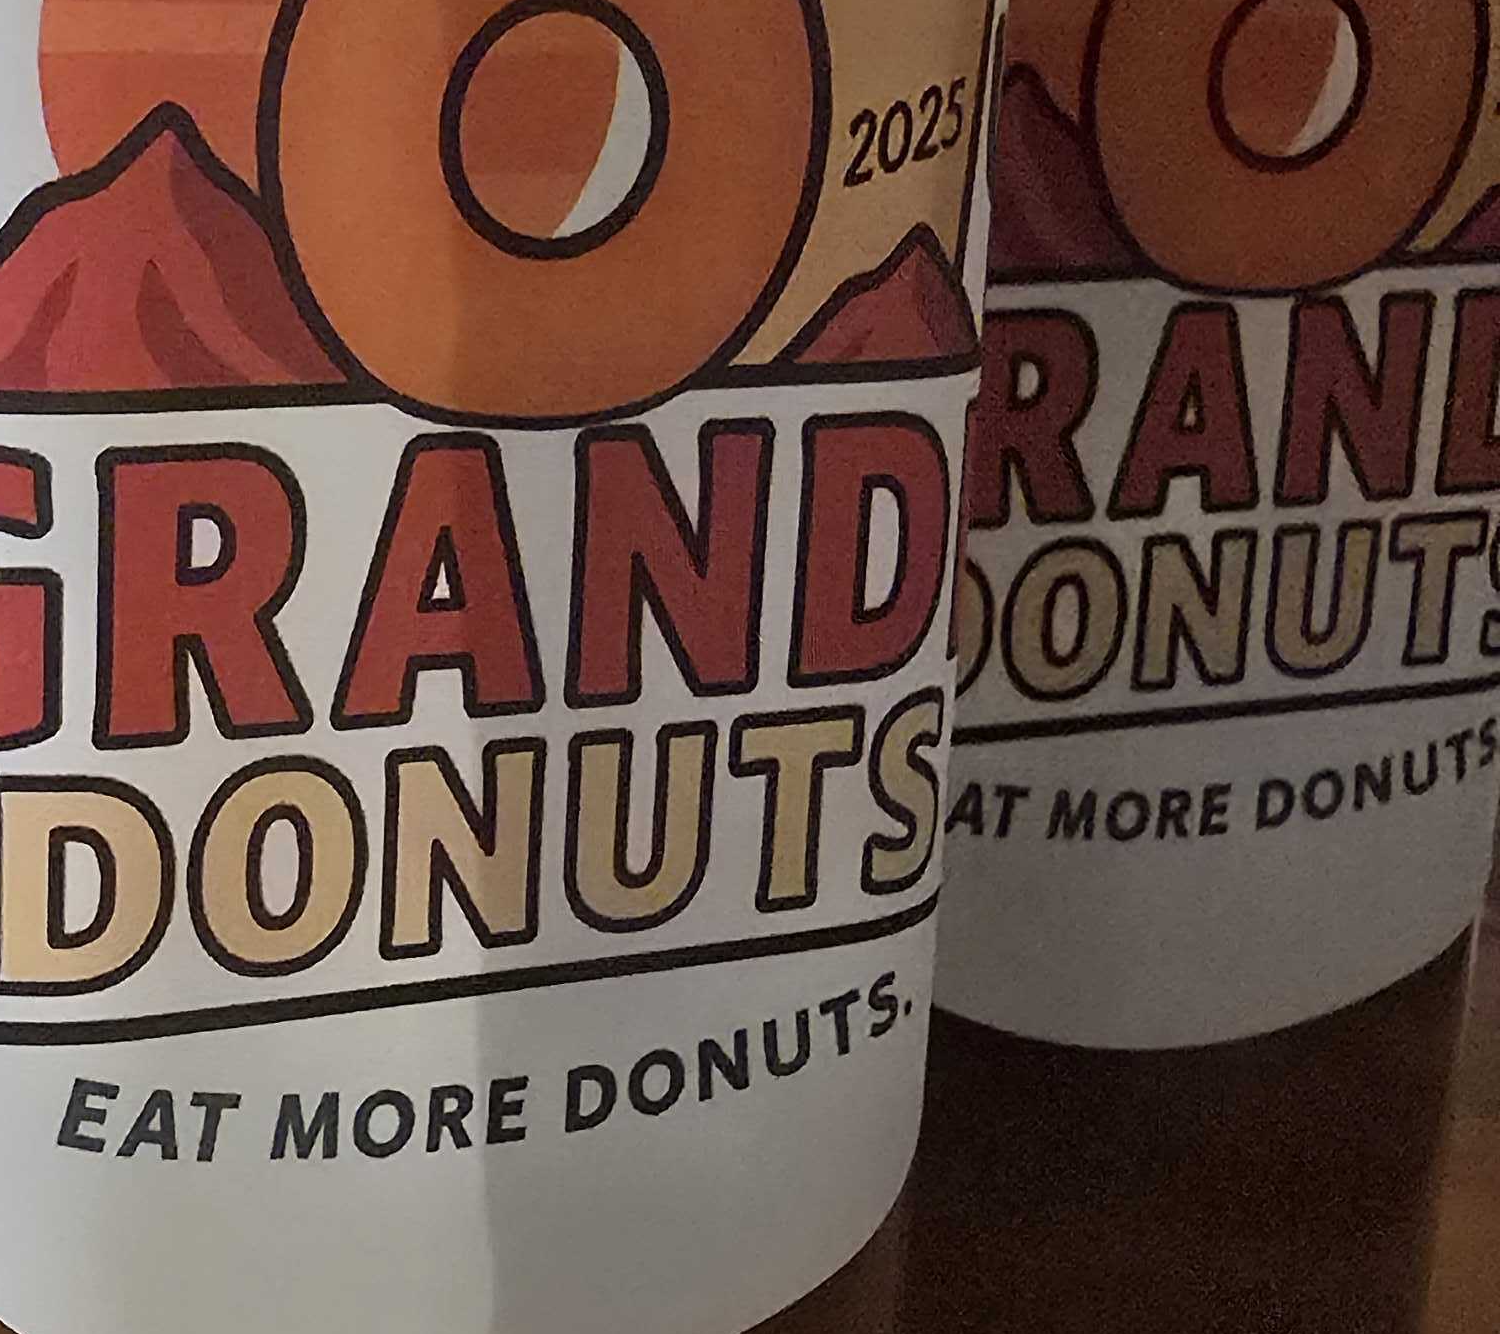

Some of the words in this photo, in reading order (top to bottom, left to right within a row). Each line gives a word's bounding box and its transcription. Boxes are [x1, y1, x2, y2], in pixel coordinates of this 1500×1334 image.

[843, 77, 966, 187] 2025
[1047, 782, 1230, 841] MORE
[57, 1078, 241, 1161] EAT
[269, 1076, 530, 1159] MORE
[564, 971, 913, 1134] DONUTS.
